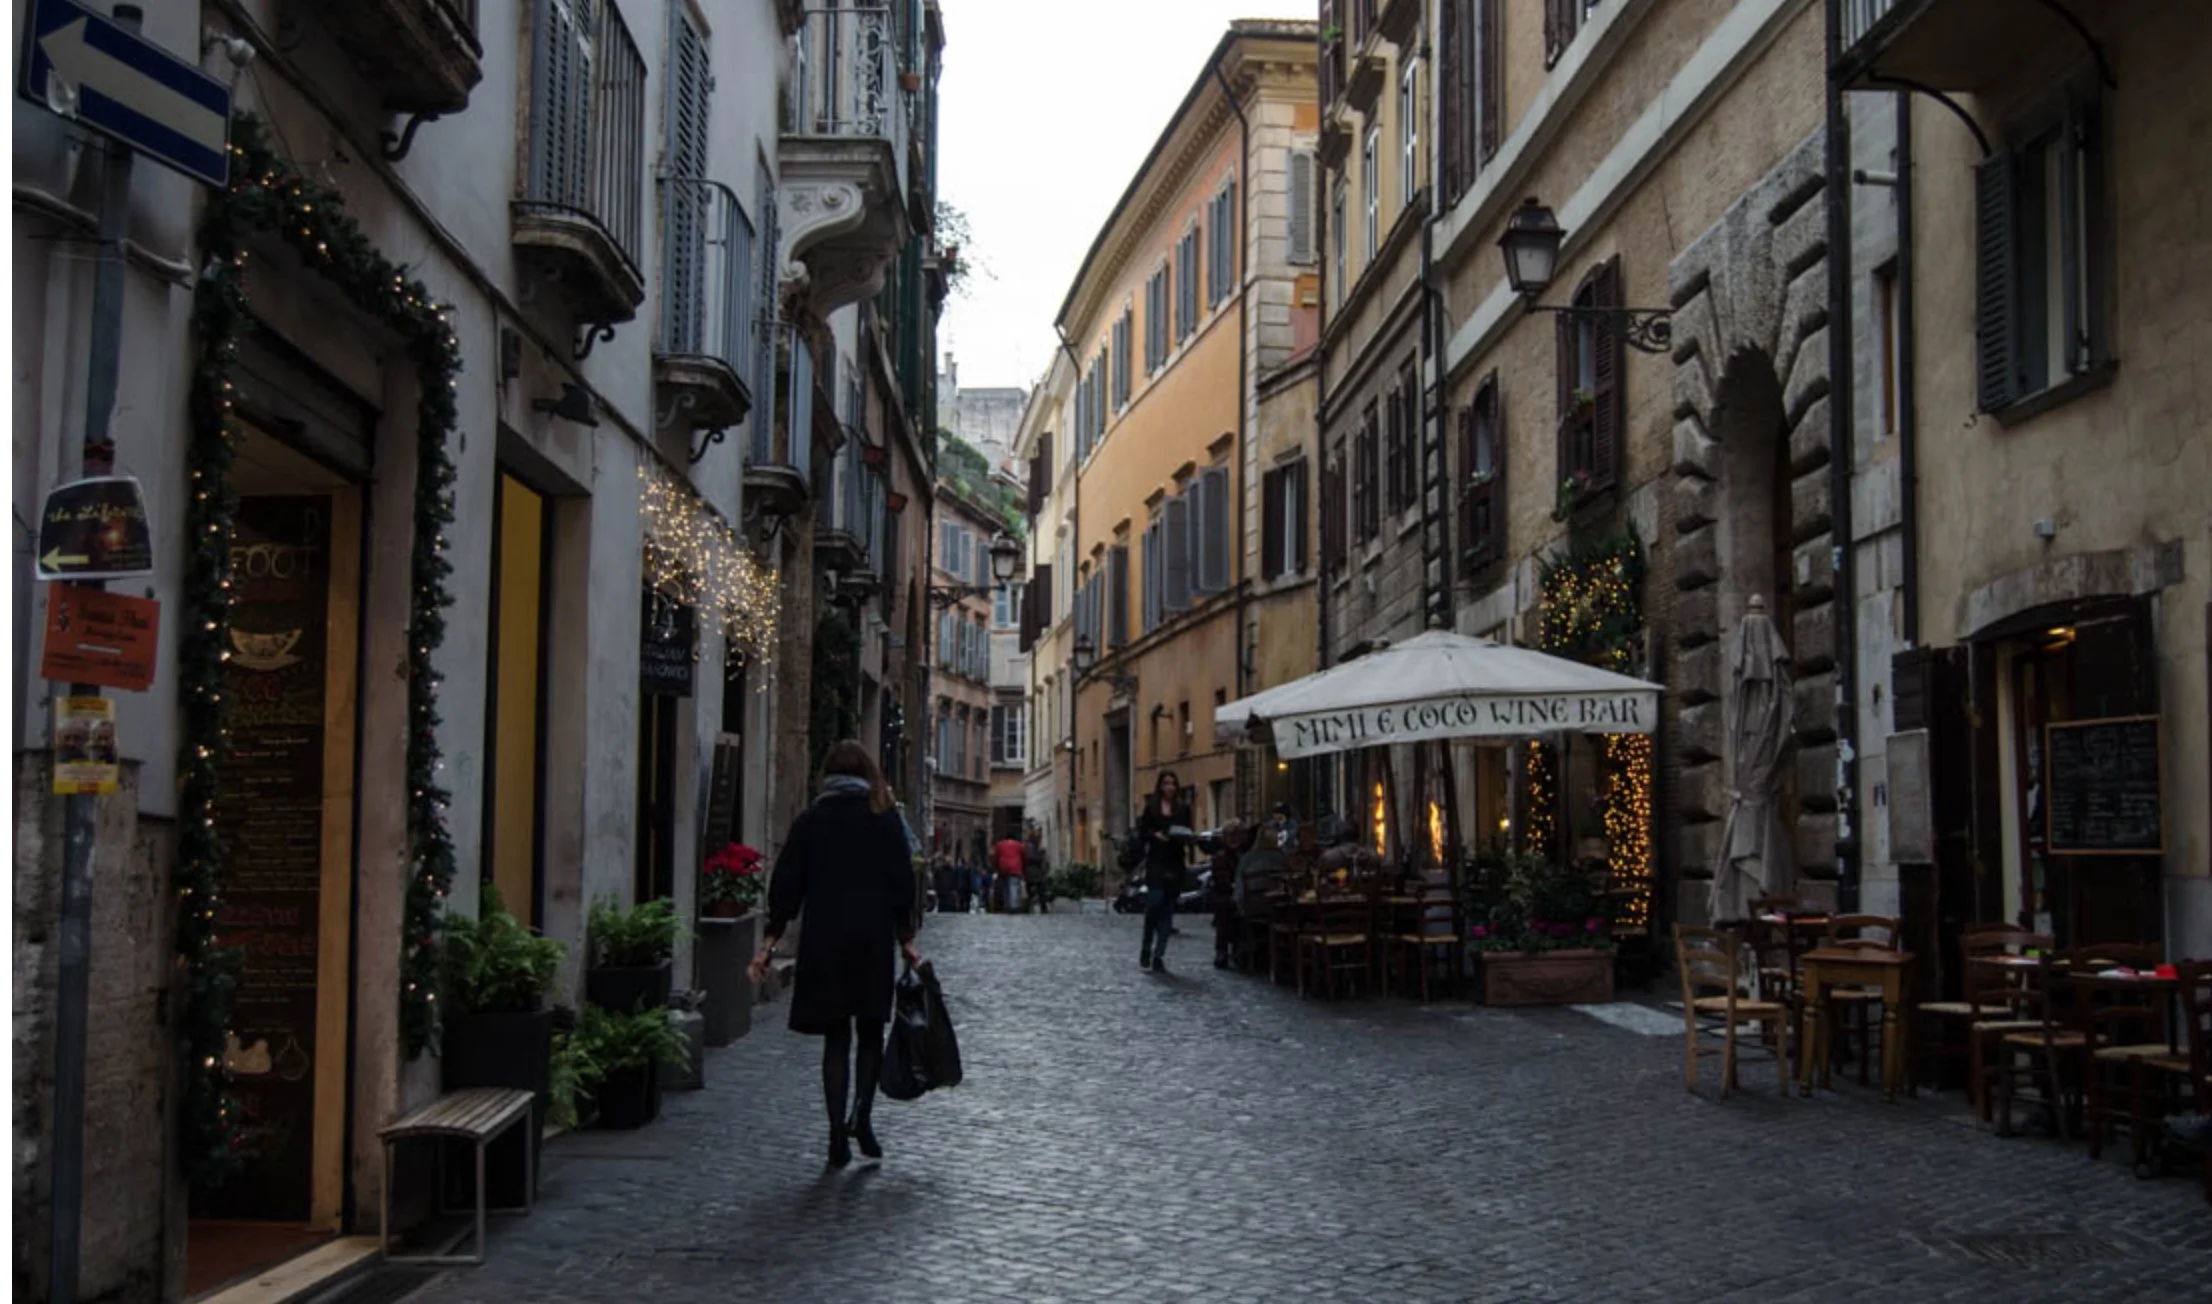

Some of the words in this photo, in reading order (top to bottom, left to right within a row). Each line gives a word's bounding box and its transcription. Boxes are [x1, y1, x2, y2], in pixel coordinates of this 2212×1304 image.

[1294, 713, 1367, 748] MIMI
[1378, 710, 1395, 733] E
[1403, 702, 1477, 731] COCO
[1490, 697, 1568, 724] WINE
[1580, 697, 1640, 724] BAR
